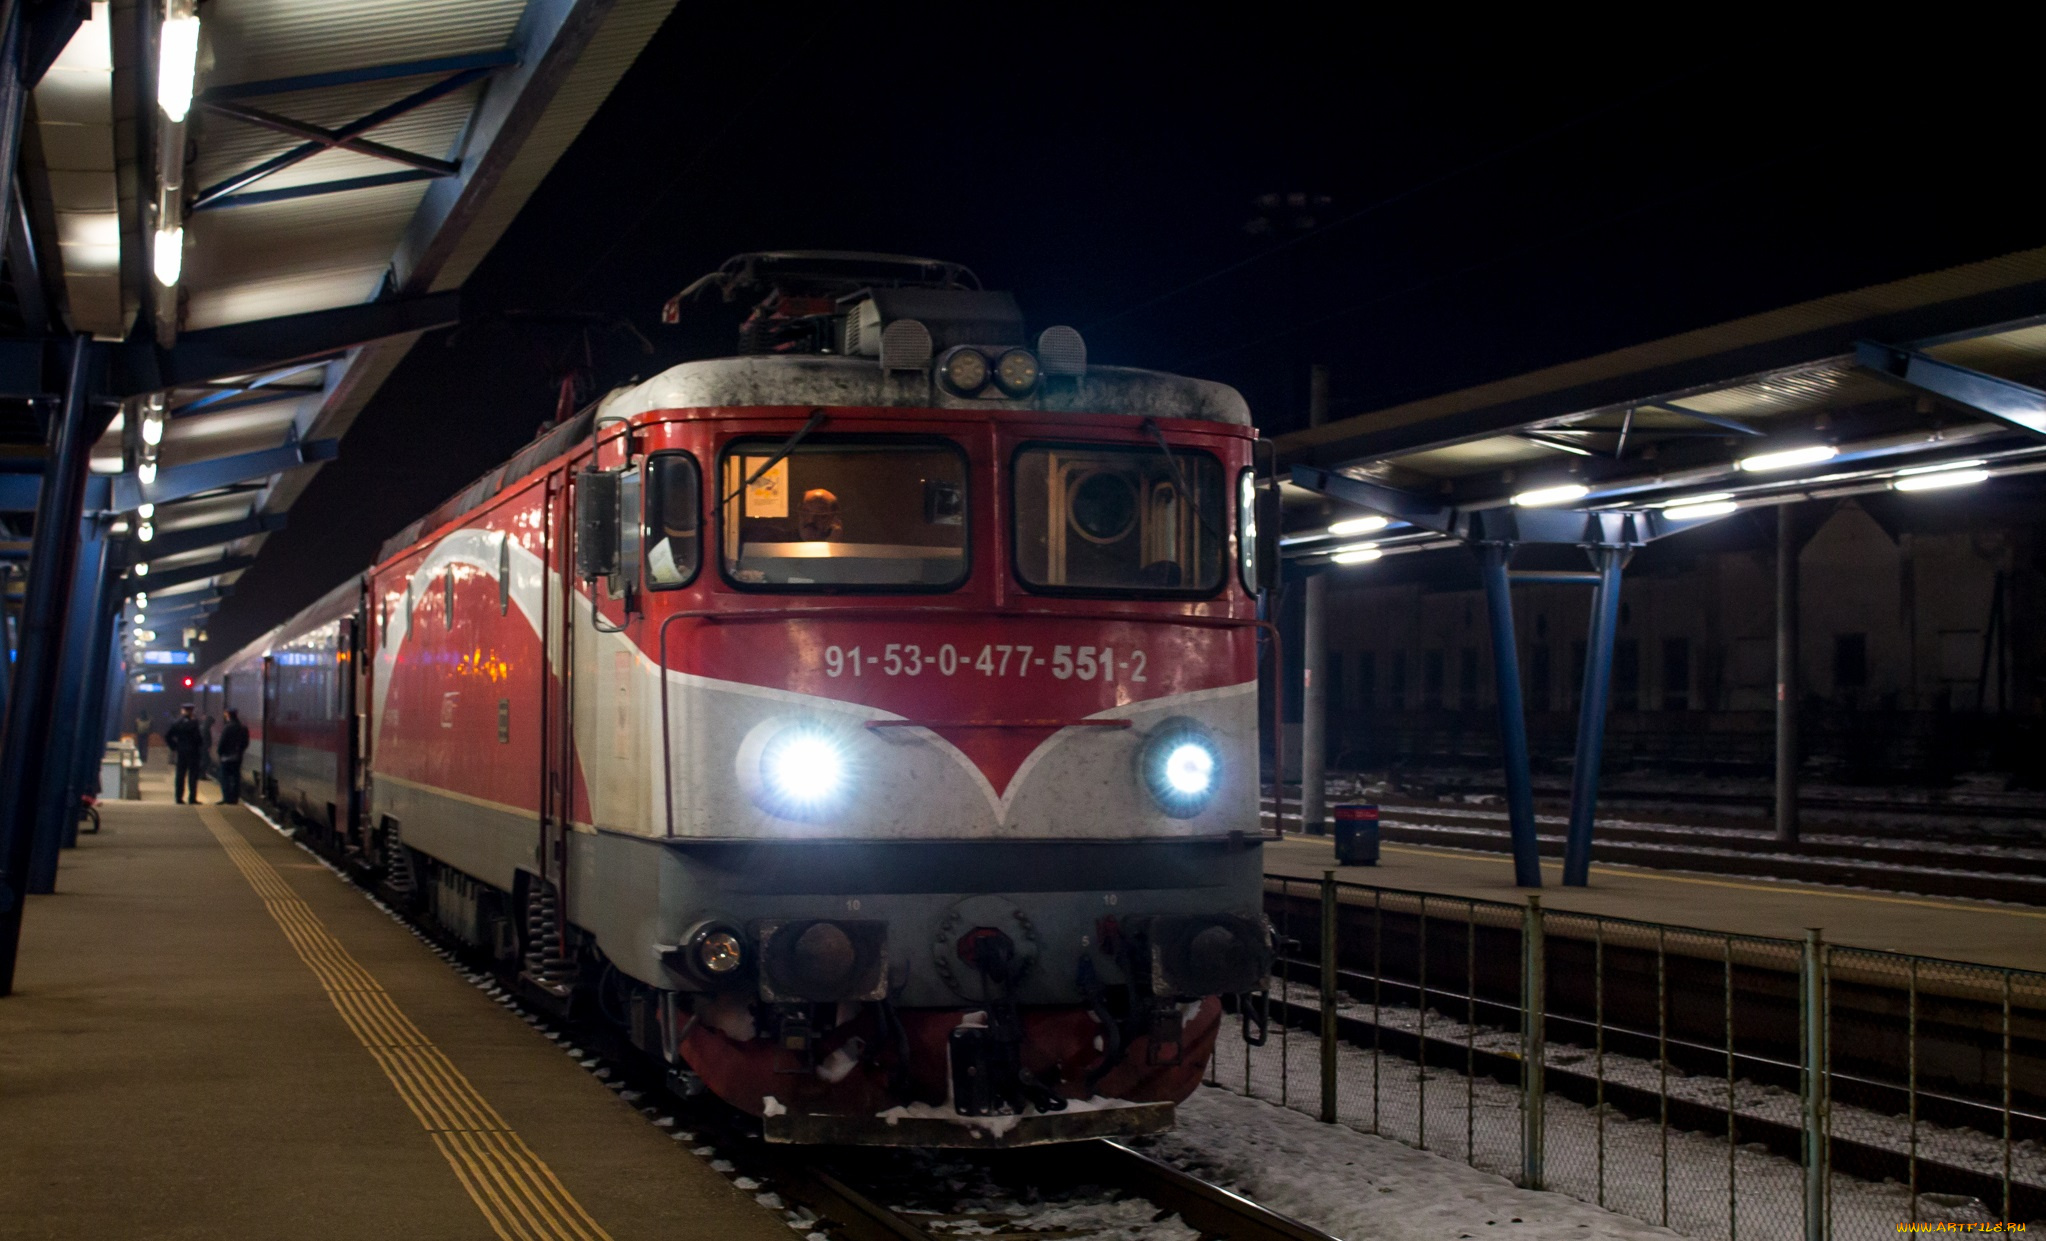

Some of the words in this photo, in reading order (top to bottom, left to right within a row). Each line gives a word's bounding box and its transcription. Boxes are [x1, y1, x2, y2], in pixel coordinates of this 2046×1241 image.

[824, 643, 1148, 683] 91-53-0-477-551-2
[846, 899, 861, 911] 10
[1103, 894, 1118, 906] 10
